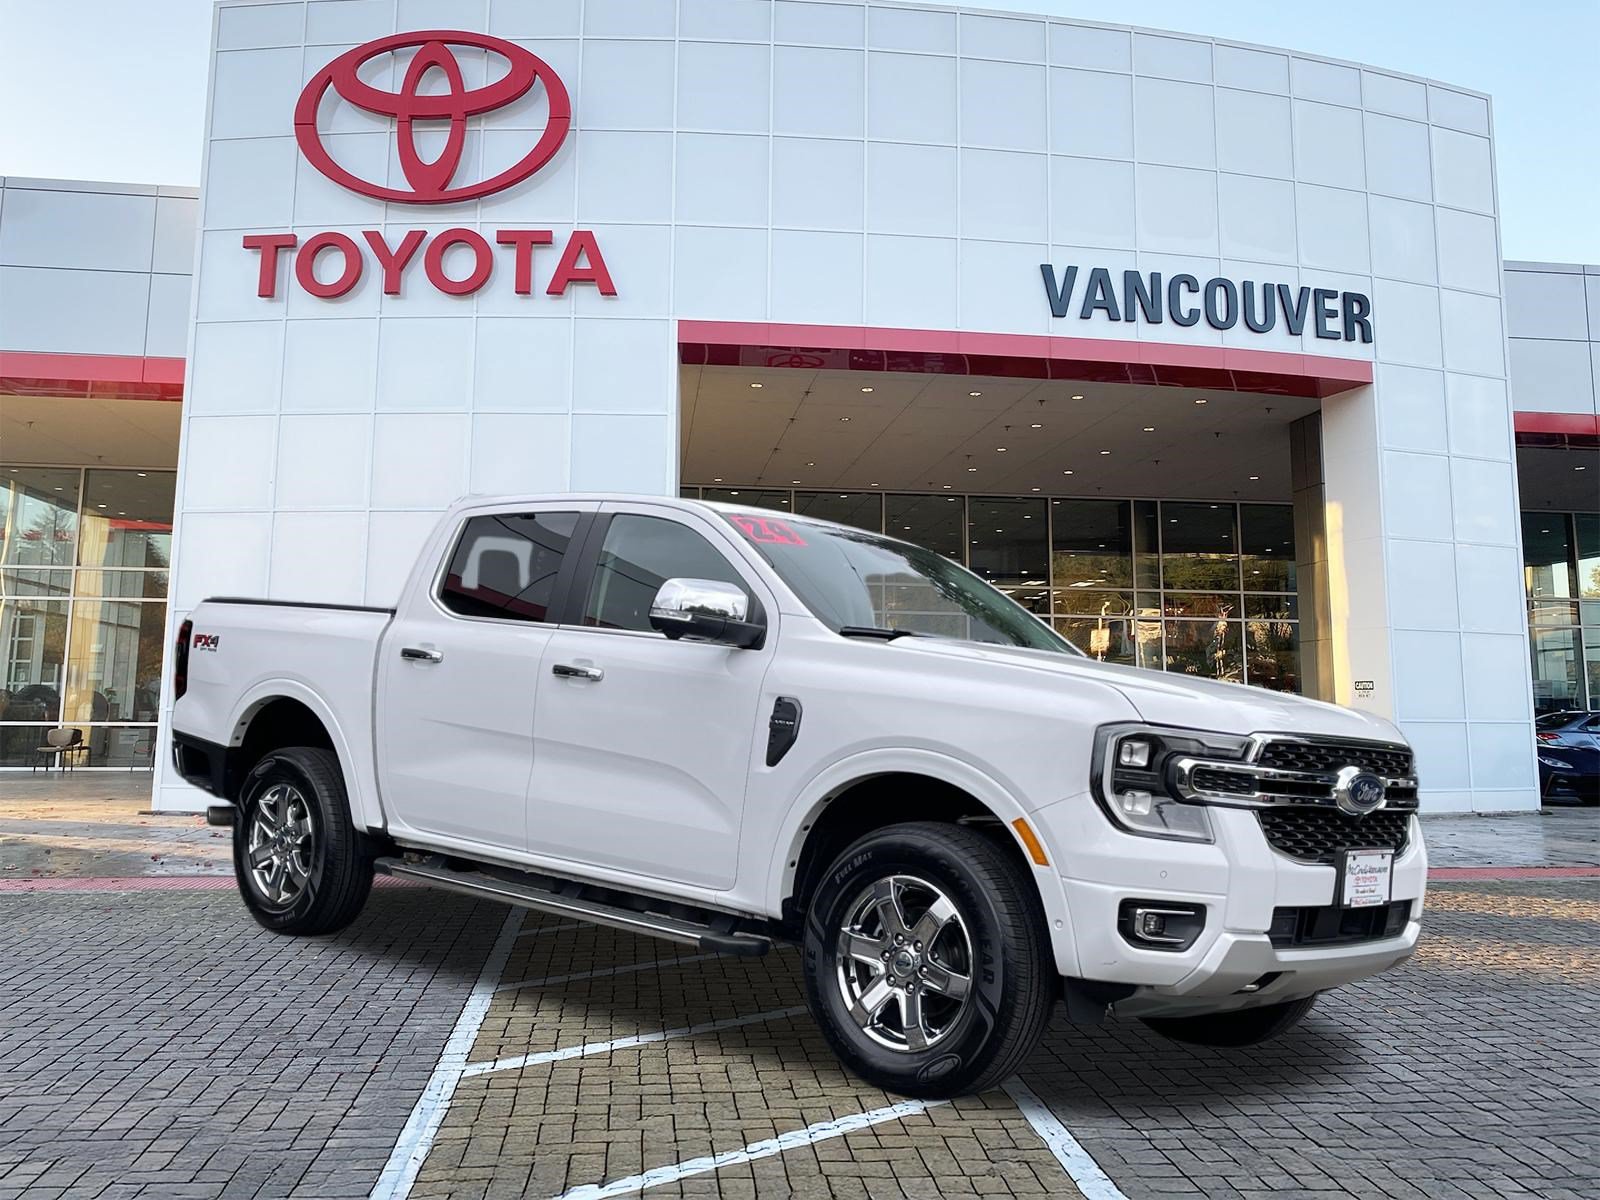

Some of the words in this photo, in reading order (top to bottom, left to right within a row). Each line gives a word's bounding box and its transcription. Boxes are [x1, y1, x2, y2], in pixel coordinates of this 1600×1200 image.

[243, 228, 617, 298] TOYOTA
[1040, 264, 1373, 343] VANCOUVER
[193, 634, 220, 648] FX4
[1357, 781, 1380, 801] Ford
